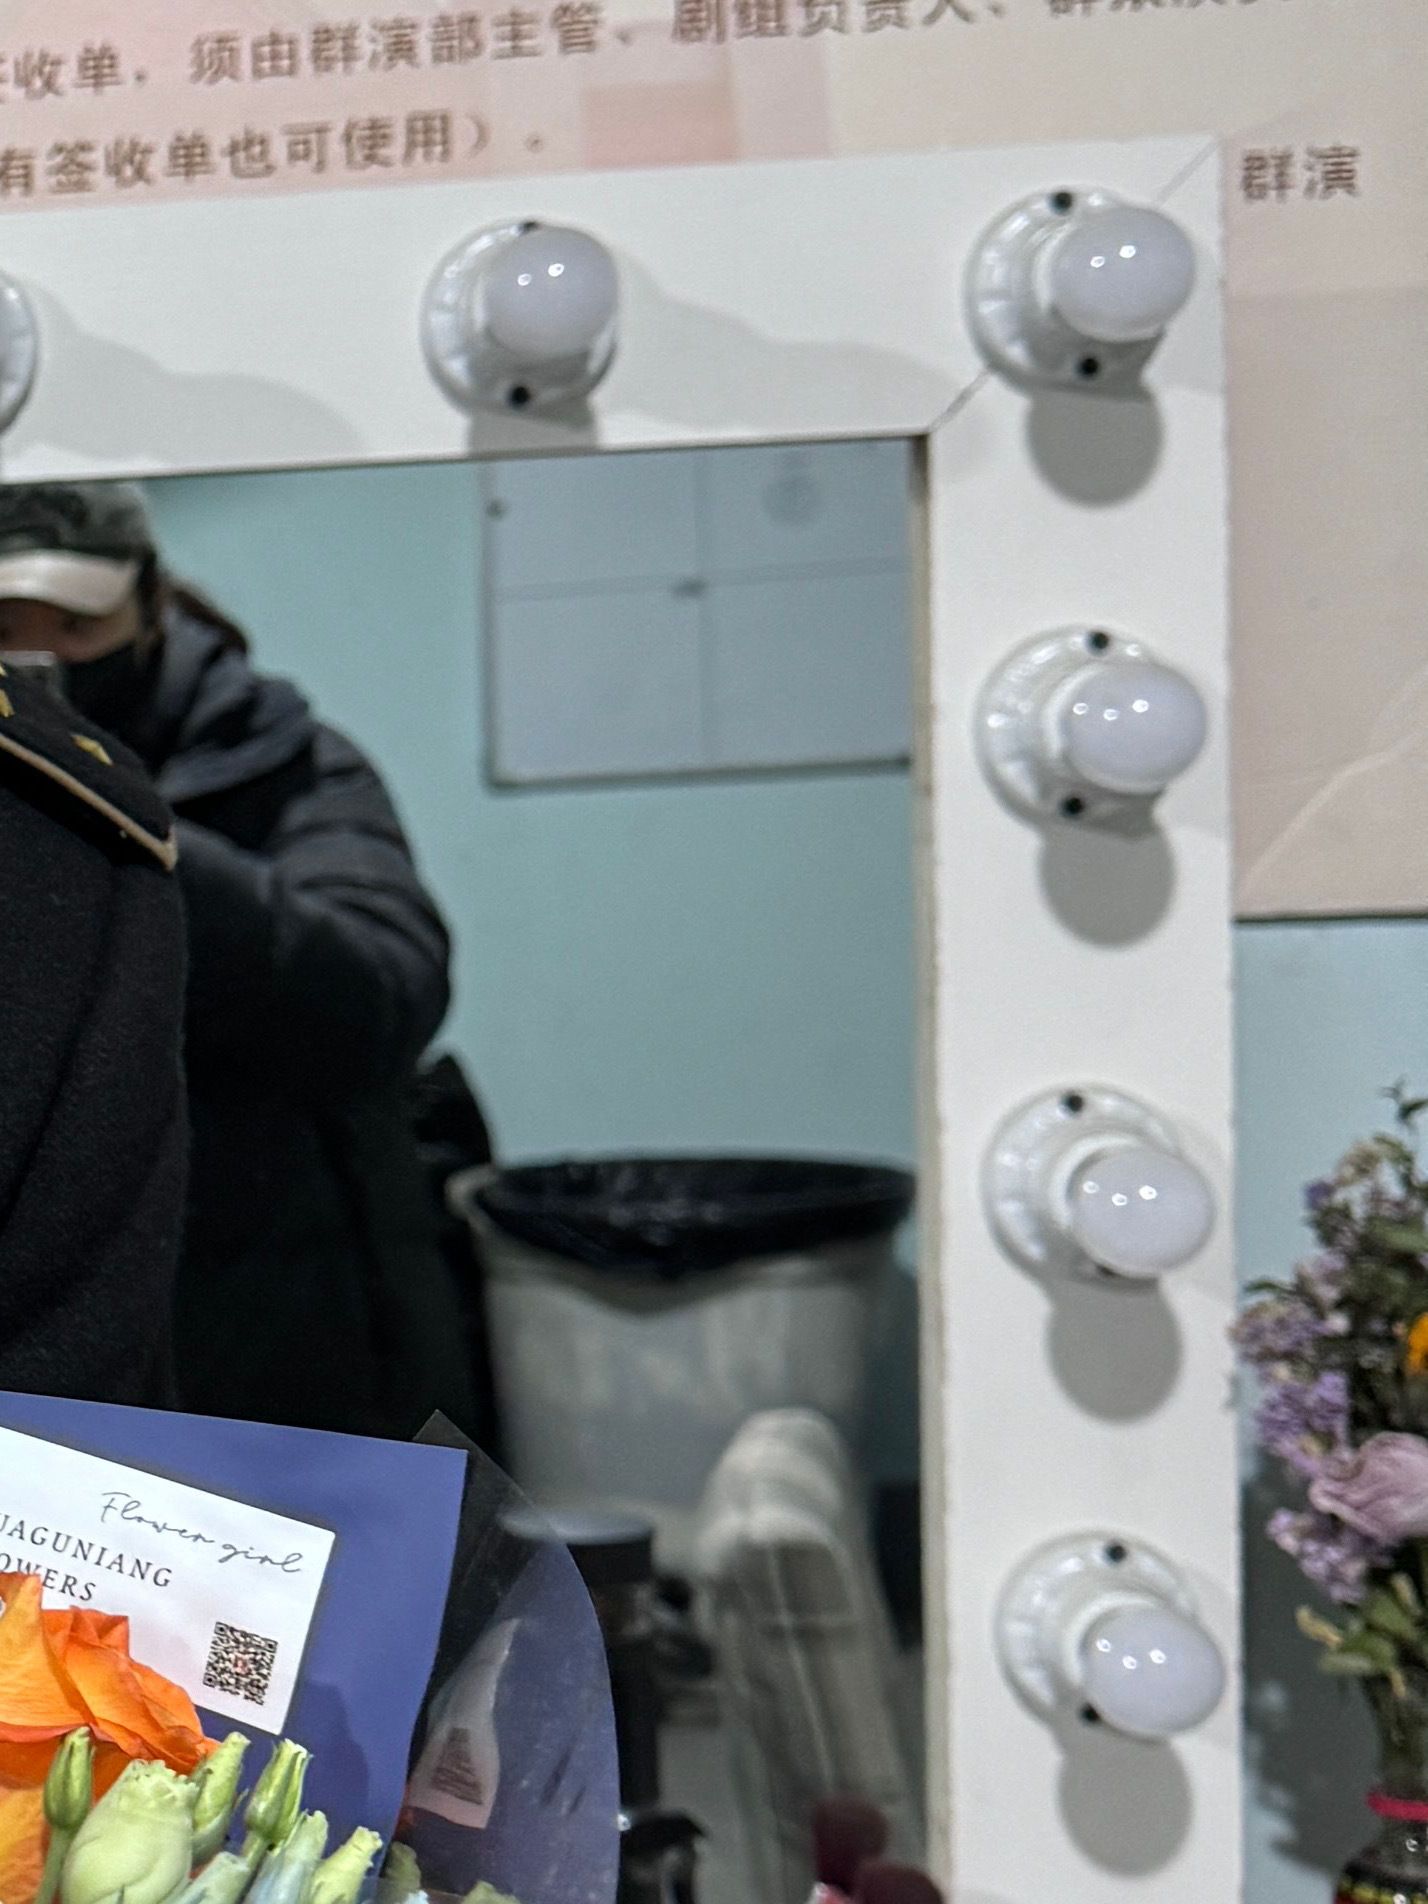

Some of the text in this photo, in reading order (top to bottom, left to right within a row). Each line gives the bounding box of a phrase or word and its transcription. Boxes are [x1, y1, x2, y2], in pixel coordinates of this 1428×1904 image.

[1240, 144, 1360, 202] 群演
[101, 1492, 303, 1574] Flower girl
